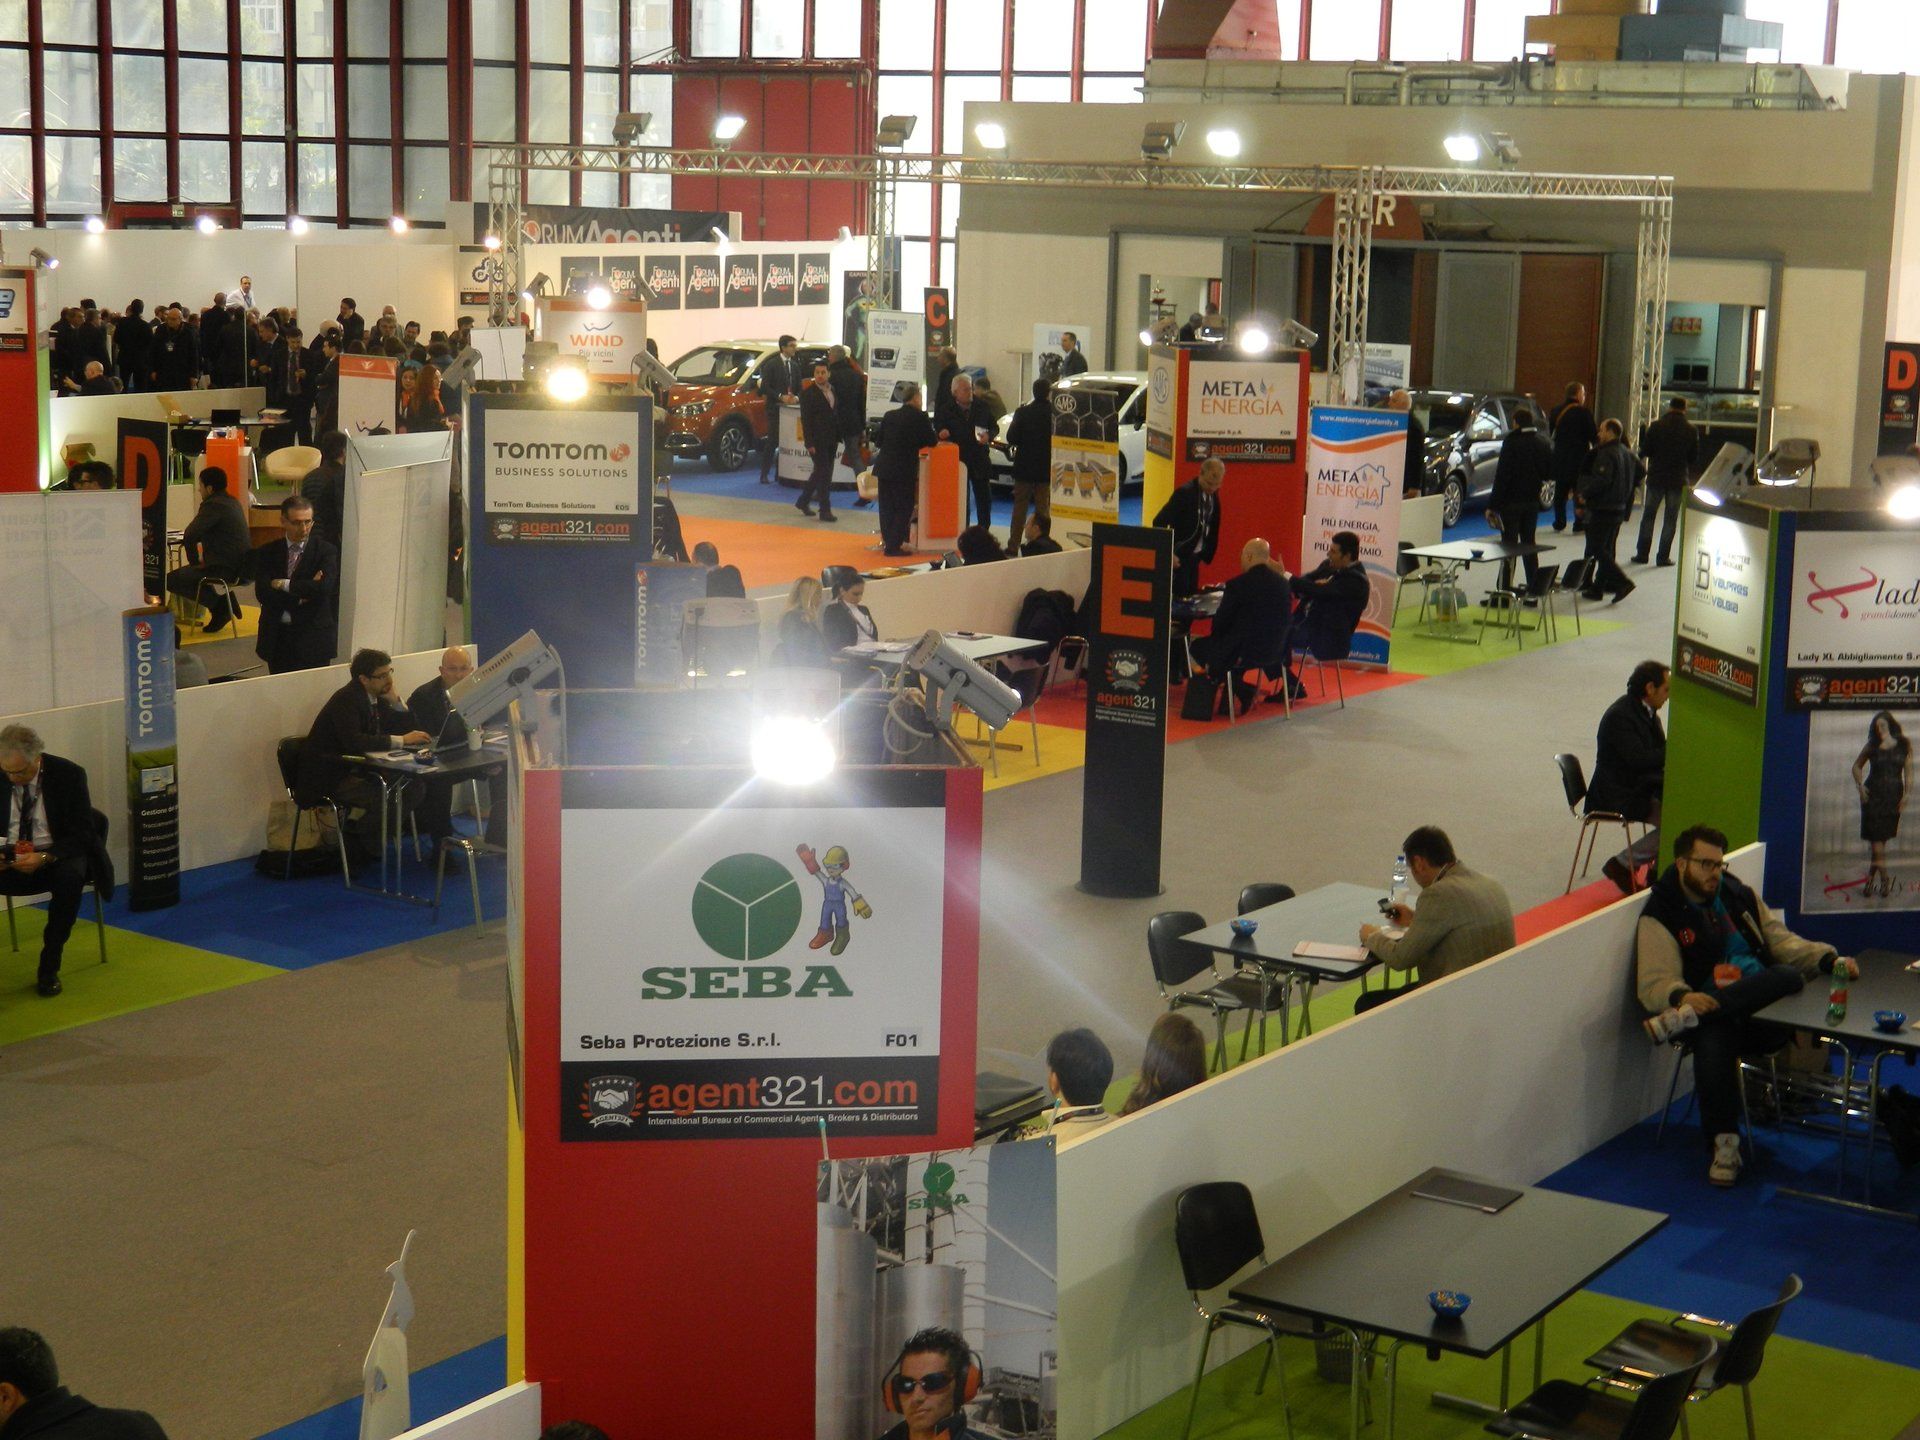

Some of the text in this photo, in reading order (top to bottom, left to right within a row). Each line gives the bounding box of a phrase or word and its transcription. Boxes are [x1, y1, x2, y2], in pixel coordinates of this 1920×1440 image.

[927, 294, 947, 328] C
[569, 334, 624, 347] WIND
[1888, 350, 1918, 390] D
[1202, 381, 1257, 396] META
[495, 467, 629, 478] BUSINESS SOLUTIONS
[1318, 468, 1360, 483] META
[1316, 482, 1380, 500] ENERGIA
[493, 500, 596, 510] TomTom Business Solutions
[520, 520, 630, 536] agent321.com
[1100, 544, 1156, 639] E
[1797, 652, 1820, 662] Lady
[1822, 652, 1834, 661] XL
[1837, 652, 1904, 663] Abbigliamento
[1096, 692, 1156, 710] agent321
[641, 965, 854, 1000] SEBA
[580, 1032, 781, 1050] Seba Protezione S.r.l.
[885, 1033, 919, 1049] F01
[648, 1075, 918, 1117] agent321.com
[648, 1117, 700, 1126] International
[702, 1116, 732, 1125] Bureau
[733, 1115, 742, 1124] of
[743, 1114, 793, 1124] Commercial
[828, 1113, 860, 1122] Brokers
[862, 1113, 868, 1121] &
[870, 1112, 918, 1122] Distributors
